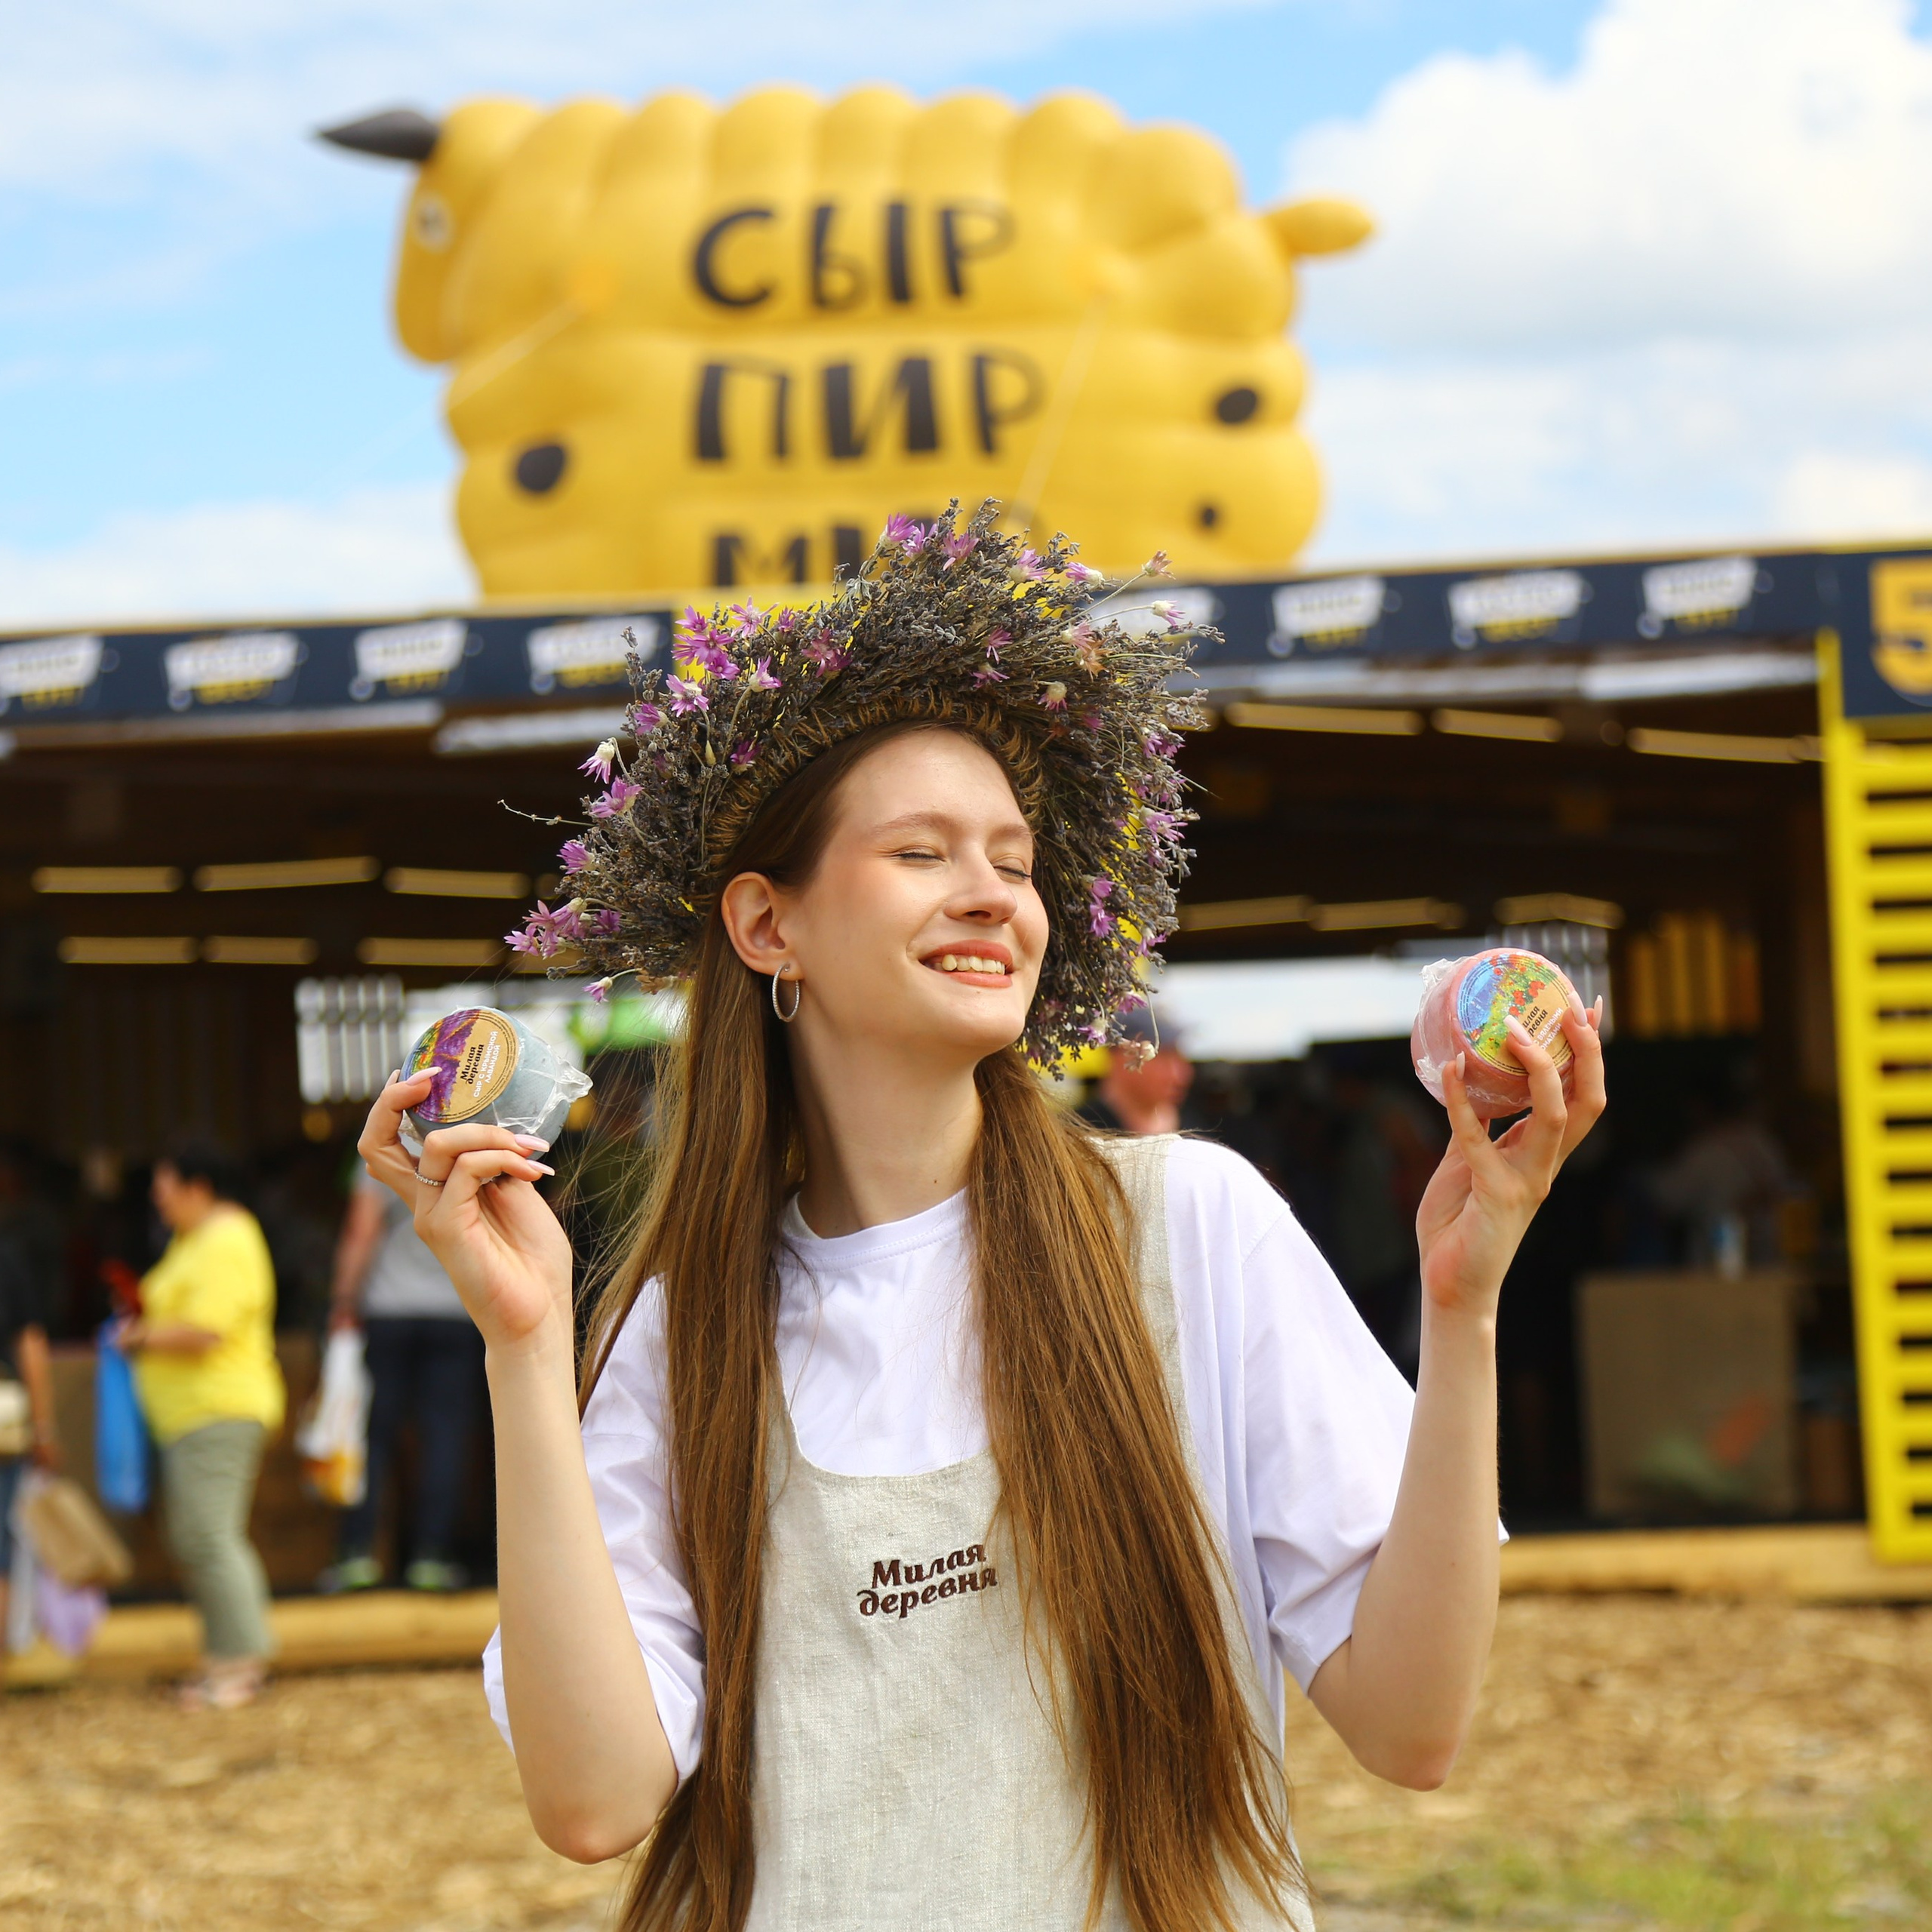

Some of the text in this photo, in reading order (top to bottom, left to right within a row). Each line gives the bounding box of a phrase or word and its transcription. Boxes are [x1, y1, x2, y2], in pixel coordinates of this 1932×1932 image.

[690, 198, 1015, 311] СЫР
[694, 346, 1048, 462] ПИР
[1522, 1006, 1540, 1028] илая
[1527, 1009, 1548, 1037] ревня
[1537, 1007, 1563, 1041] ВЯЛЕНЫМИ
[1540, 1023, 1561, 1051] ОМАТАМИ
[460, 1046, 476, 1081] Милая
[466, 1044, 485, 1084] деревня
[473, 1081, 482, 1097] СЫР
[481, 1031, 498, 1072] КРЫМСКОЙ
[485, 1044, 501, 1084] ЛАВАНДОЙ
[872, 1544, 986, 1589] Милая
[857, 1567, 998, 1620] деревня
